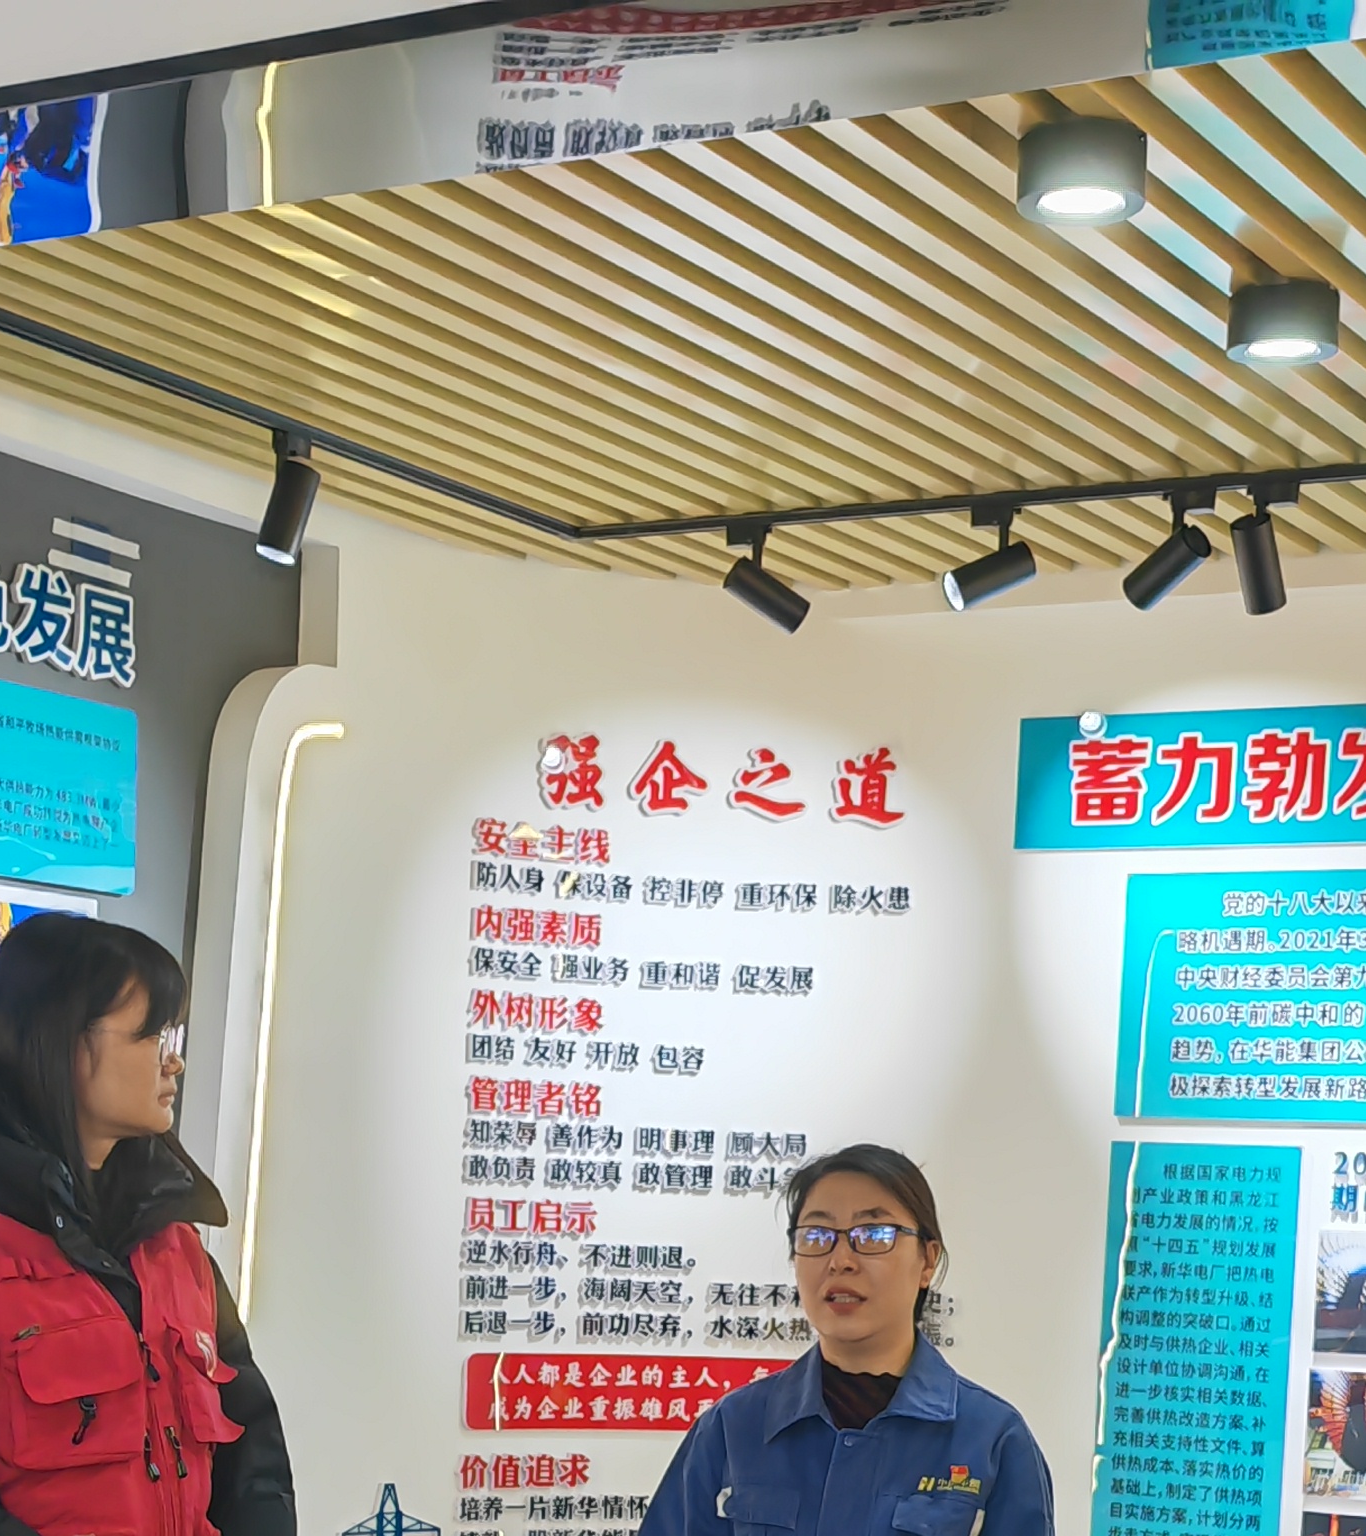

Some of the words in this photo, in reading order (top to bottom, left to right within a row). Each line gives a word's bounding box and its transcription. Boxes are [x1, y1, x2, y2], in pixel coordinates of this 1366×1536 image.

[542, 733, 906, 824] 强企之道
[478, 818, 611, 864] 安全主线
[477, 861, 544, 892] 防人身
[648, 876, 724, 904] 控非停
[738, 883, 818, 910] 重环保
[833, 884, 911, 911] 除火患
[474, 907, 603, 946] 内强素质
[473, 951, 543, 978] 保安全
[645, 962, 721, 989] 重和谐
[738, 965, 814, 992] 促发展
[470, 992, 604, 1032] 外树形象
[471, 1034, 515, 1063] 团结
[528, 1038, 578, 1065] 友好
[590, 1042, 639, 1069] 开放
[655, 1045, 704, 1072] 包容
[469, 1078, 602, 1118] 管理者铭
[469, 1120, 537, 1147] 知荣辱
[551, 1124, 622, 1152] 善作为
[639, 1128, 715, 1154] 明事理
[731, 1132, 806, 1157] 顾大局
[468, 1158, 536, 1185] 敢负责
[550, 1160, 621, 1187] 敢较真
[638, 1163, 713, 1189] 敢管理
[1163, 1164, 1281, 1183] 根据国家电力规
[466, 1198, 597, 1235] 员工启示
[1118, 1334, 1270, 1358] 及时与供热企业、相关
[1115, 1381, 1268, 1408] 进一步核实相关数据、
[1114, 1405, 1266, 1432] 完善供热改造方案、补
[460, 1454, 591, 1490] 价值追求
[1111, 1454, 1264, 1482] 供热成本、落实热价的
[458, 1495, 649, 1521] 培养一片新华情怀
